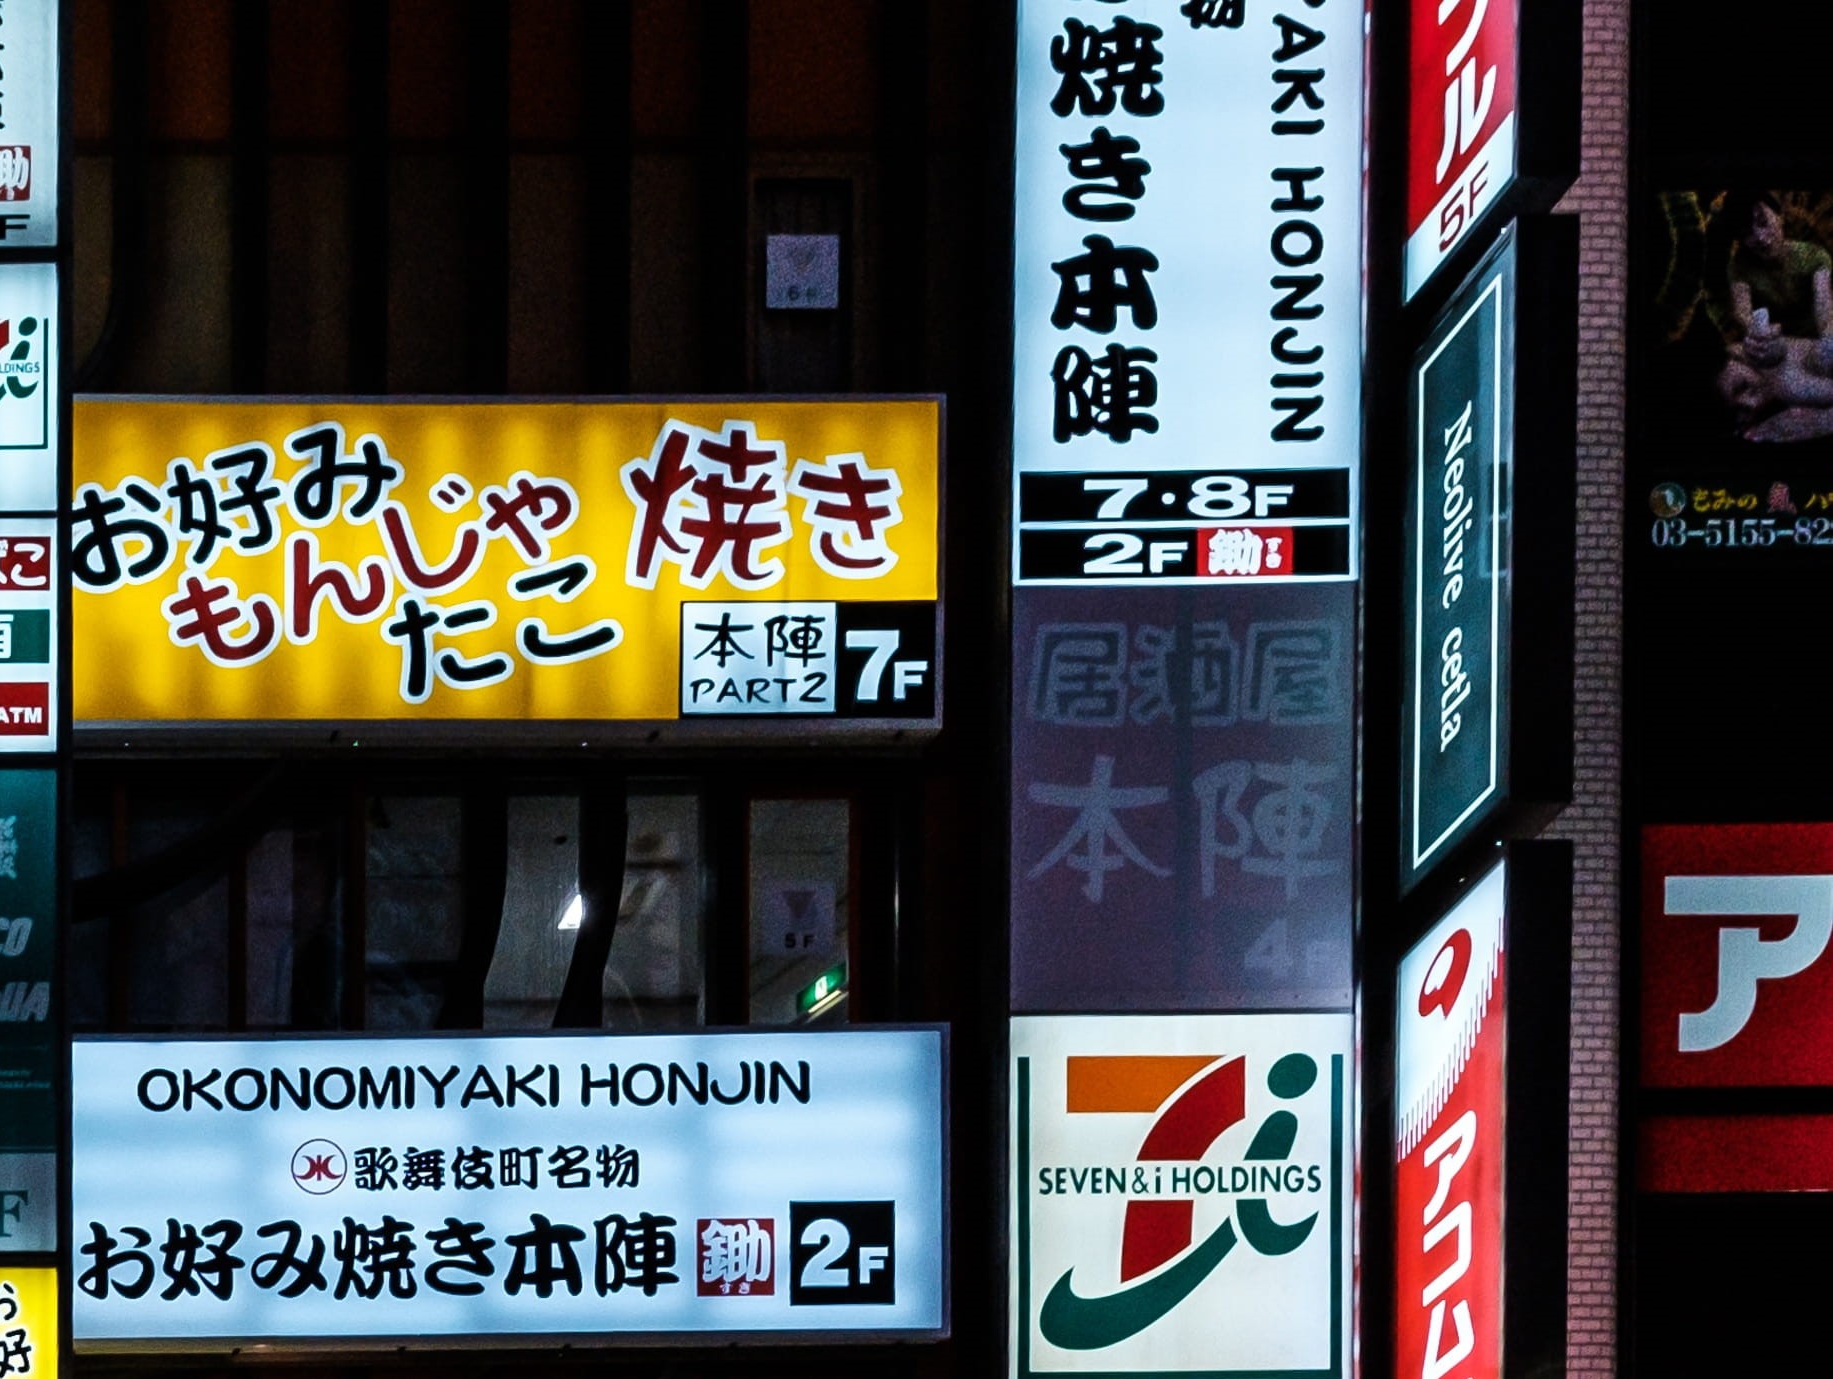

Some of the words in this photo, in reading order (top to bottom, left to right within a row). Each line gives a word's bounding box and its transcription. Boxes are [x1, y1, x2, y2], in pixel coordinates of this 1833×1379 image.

[1439, 161, 1489, 254] 5F
[1271, 166, 1326, 444] HONJIN
[72, 427, 398, 587] お好み
[632, 427, 900, 583] 焼き
[1442, 400, 1475, 611] Neolive
[172, 474, 572, 663] もんじゃ
[1083, 531, 1189, 575] 2F
[388, 562, 618, 698] たこ
[693, 610, 828, 668] 本陣
[845, 630, 929, 704] 7F
[137, 1062, 562, 1113] OKONOMIYAKI
[580, 1061, 812, 1105] HONJIN
[353, 1144, 641, 1192] 歌舞伎町名物
[1171, 1164, 1322, 1195] HOLDINGS
[77, 1213, 680, 1303] お好み焼き本陣
[798, 1228, 892, 1289] 2F
